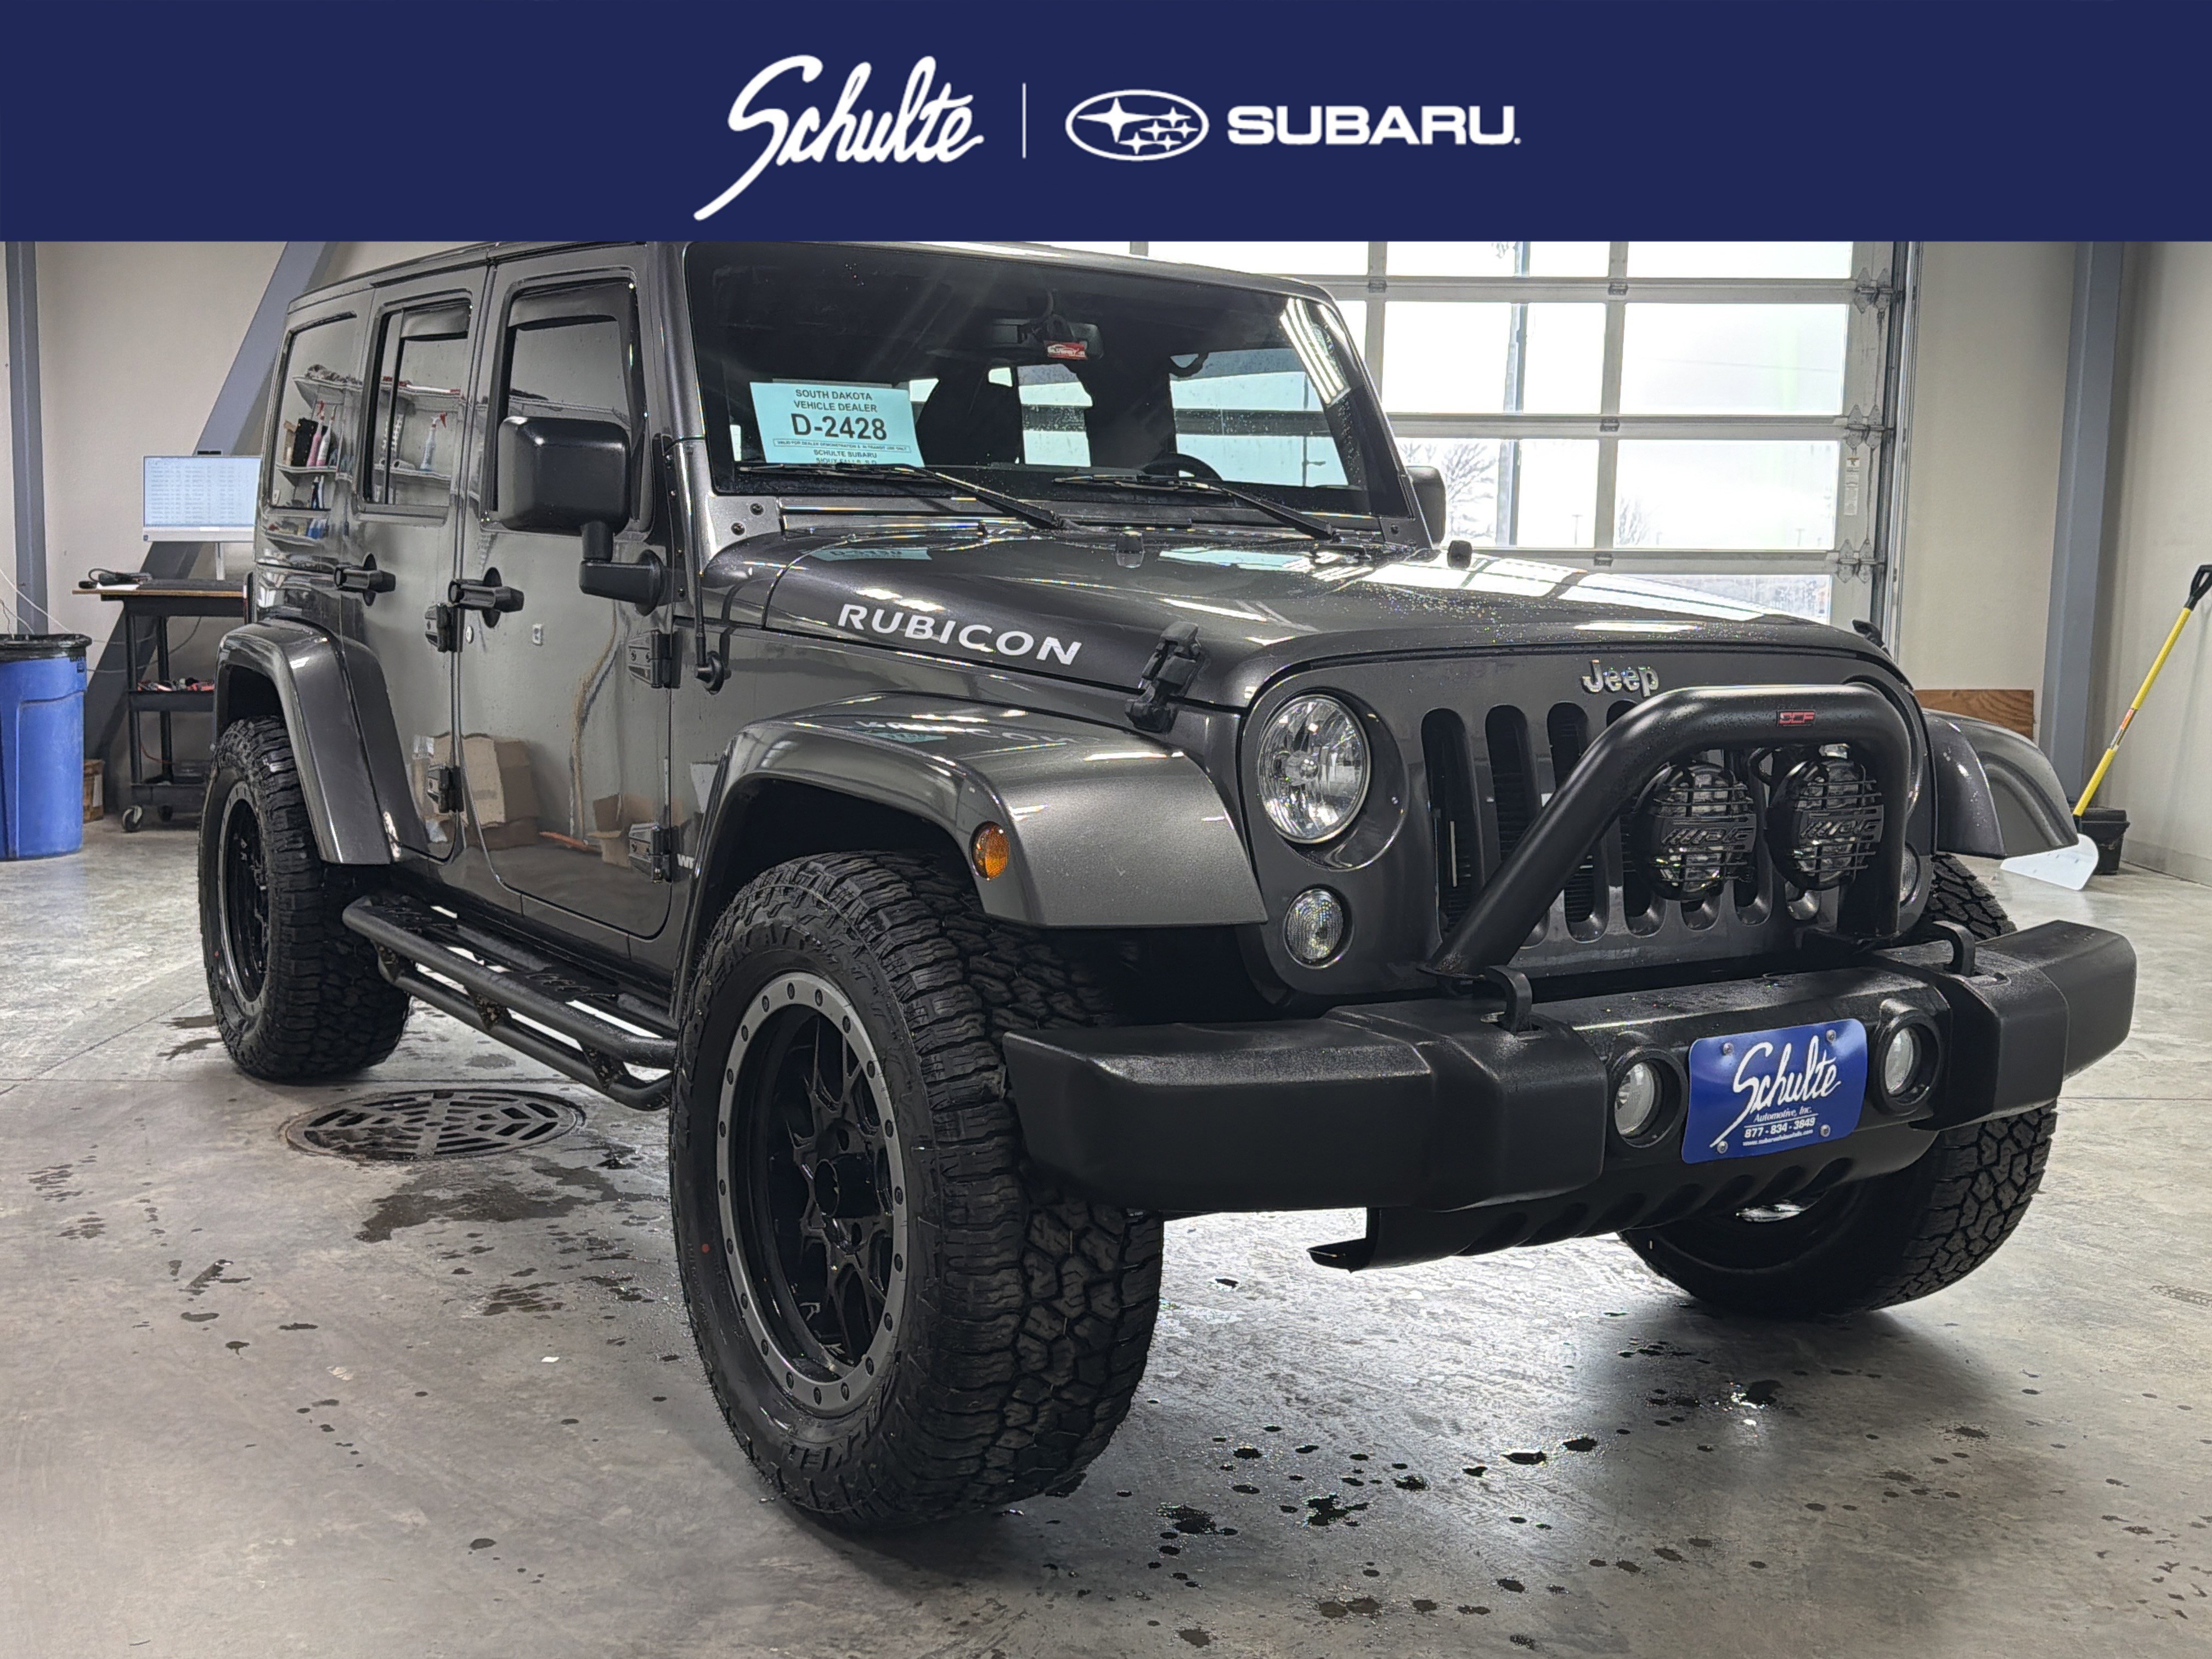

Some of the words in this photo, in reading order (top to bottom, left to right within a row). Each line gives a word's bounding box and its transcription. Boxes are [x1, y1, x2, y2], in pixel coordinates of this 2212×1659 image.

[795, 389, 830, 399] SOUTH
[832, 391, 873, 400] DAKOTA
[793, 400, 836, 411] VEHICLE
[838, 403, 878, 413] DEALER
[791, 413, 887, 441] D-2428
[814, 449, 846, 458] SCHULTE
[838, 603, 1082, 665] RUBICON
[1582, 659, 1658, 697] Jeep
[1709, 1035, 1841, 1148] Schulte
[1799, 1105, 1812, 1115] Inc.
